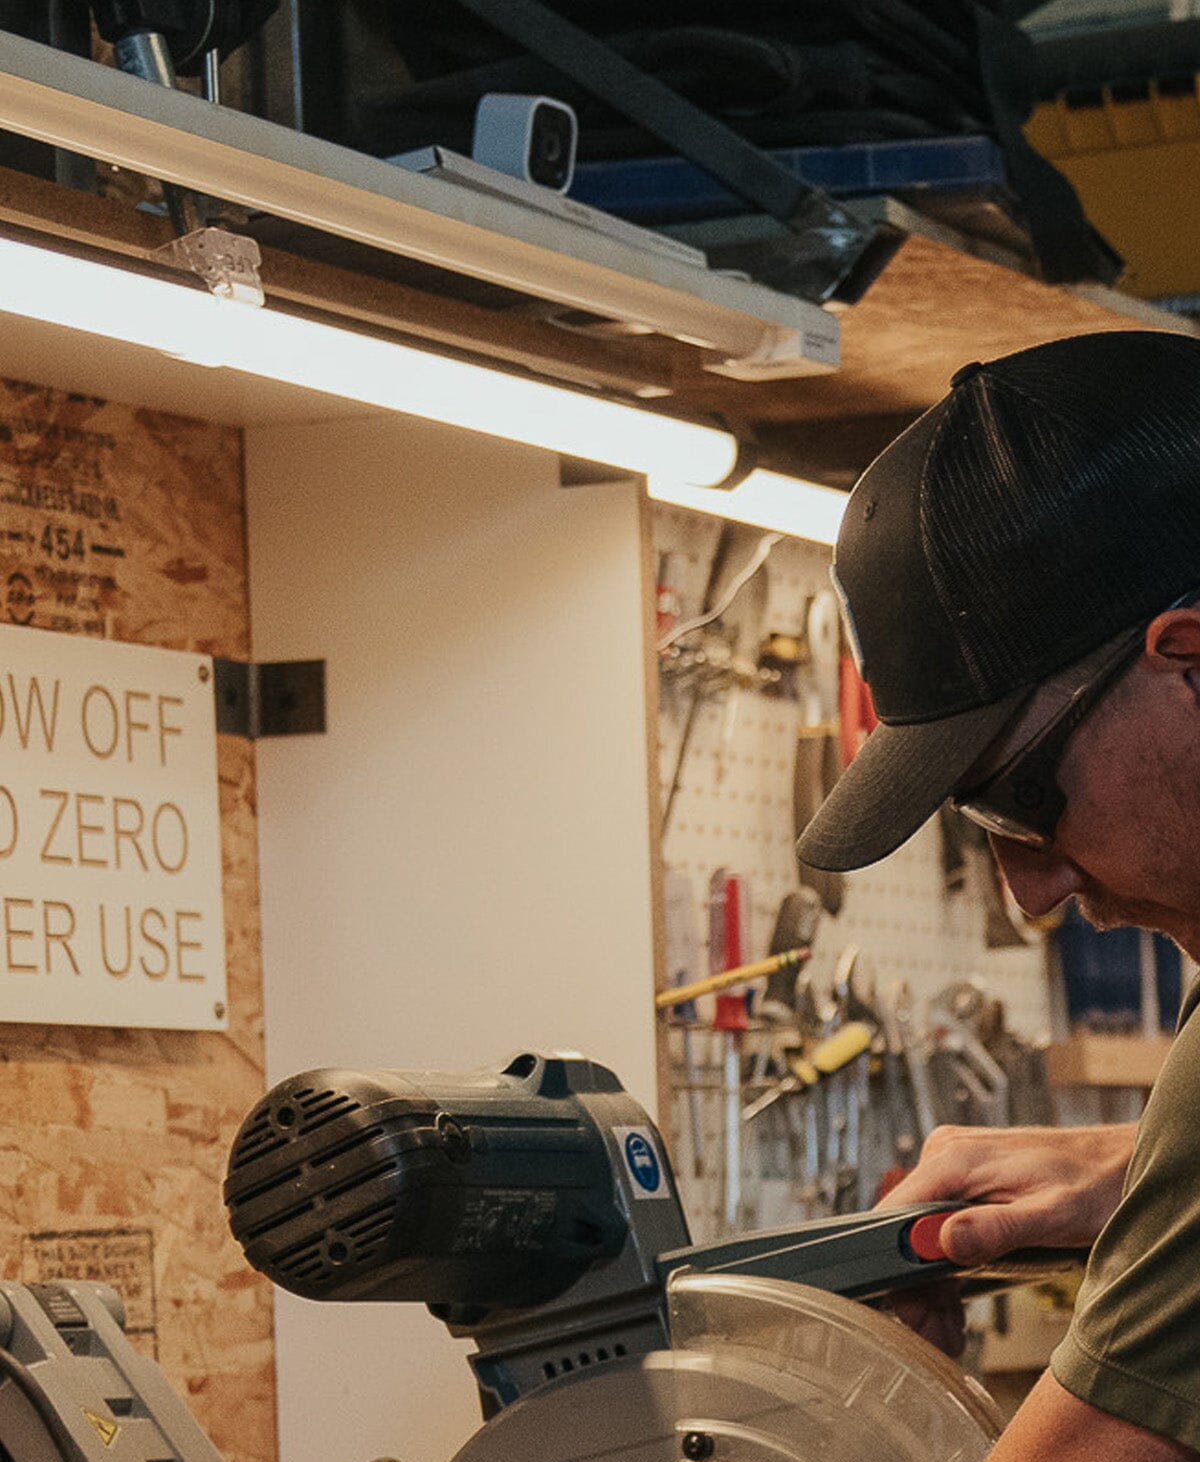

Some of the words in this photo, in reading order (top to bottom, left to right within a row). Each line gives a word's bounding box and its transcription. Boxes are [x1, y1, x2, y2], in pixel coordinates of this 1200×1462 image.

[0, 673, 60, 751] W
[81, 685, 184, 766] OFF
[39, 788, 188, 873] ZERO
[4, 898, 80, 975] ER
[100, 904, 205, 982] USE
